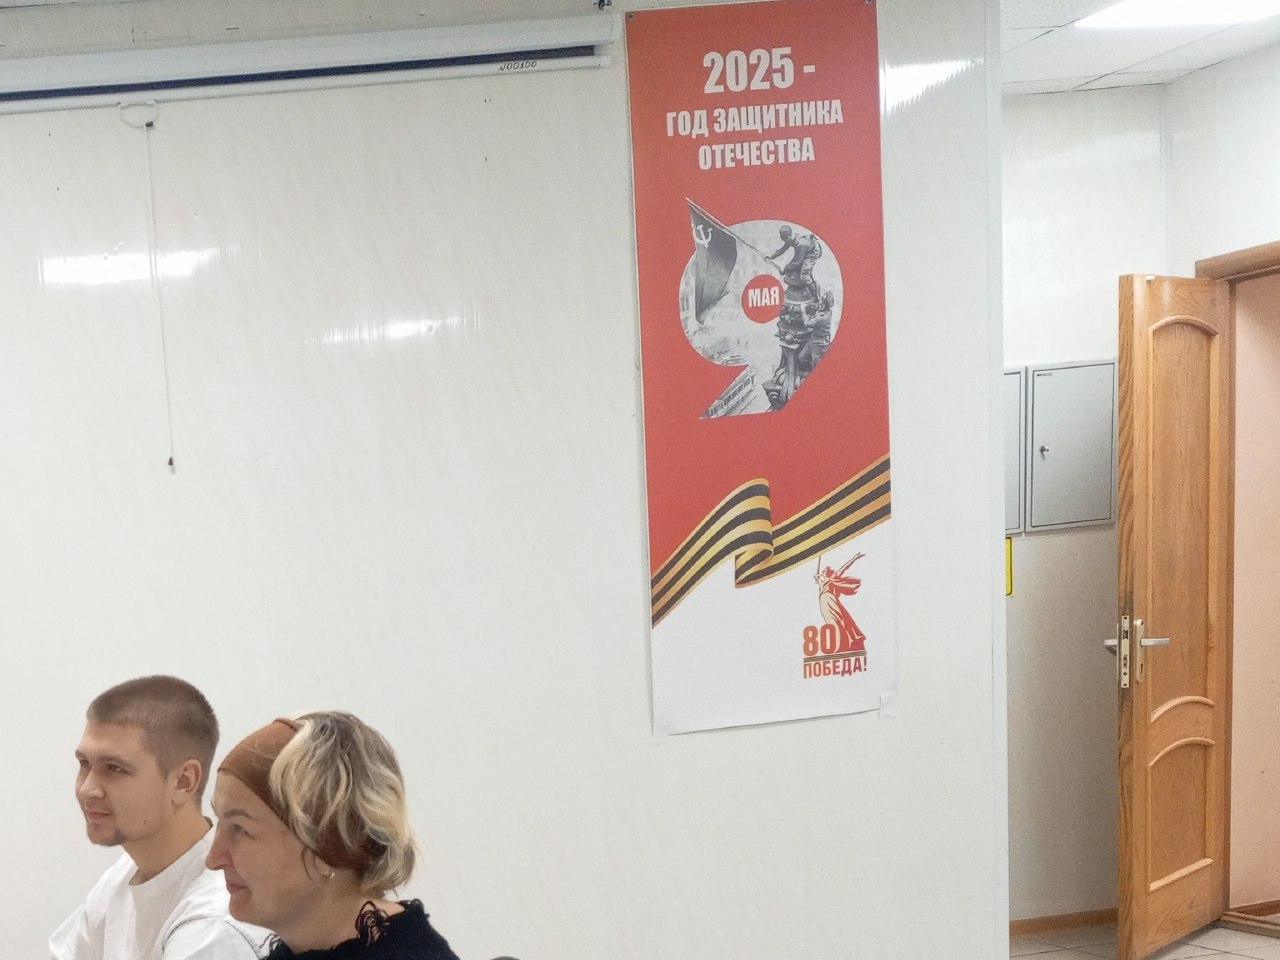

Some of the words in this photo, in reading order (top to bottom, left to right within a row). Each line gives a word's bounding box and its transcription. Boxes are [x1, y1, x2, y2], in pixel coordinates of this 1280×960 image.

[703, 47, 795, 94] 2025
[803, 64, 816, 73] -
[666, 110, 709, 139] ГОД
[713, 99, 844, 134] ЗАЩИТНИКА
[698, 136, 816, 170] ОТЕЧЕСТВА
[748, 286, 780, 308] МАЯ
[803, 623, 837, 657] 80
[803, 656, 867, 679] ПОБЕДА!
